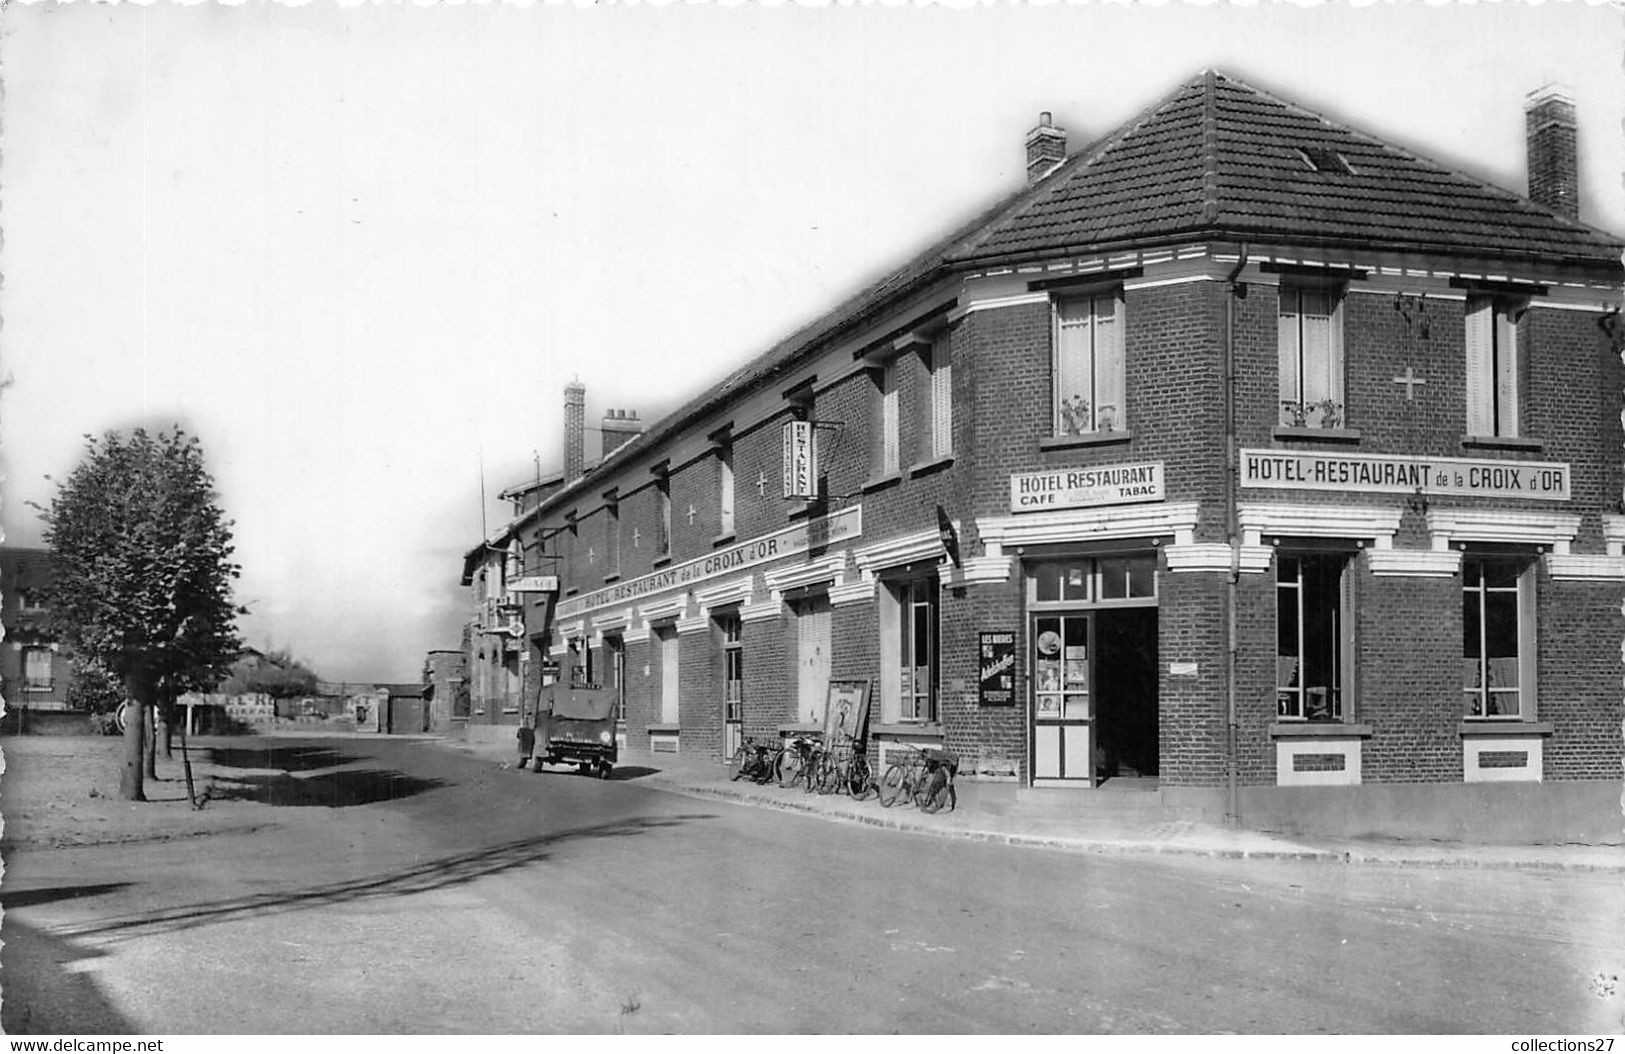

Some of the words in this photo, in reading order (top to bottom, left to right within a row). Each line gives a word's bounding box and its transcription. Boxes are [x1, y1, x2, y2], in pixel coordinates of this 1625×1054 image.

[796, 423, 807, 494] RESTAURANT
[1066, 466, 1156, 490] RESTAURANT
[1436, 471, 1449, 487] de
[1454, 472, 1464, 487] la
[1469, 467, 1522, 490] CROIX
[1529, 470, 1563, 492] d'OR
[1118, 485, 1157, 498] TABAC
[704, 549, 745, 574] CROIX
